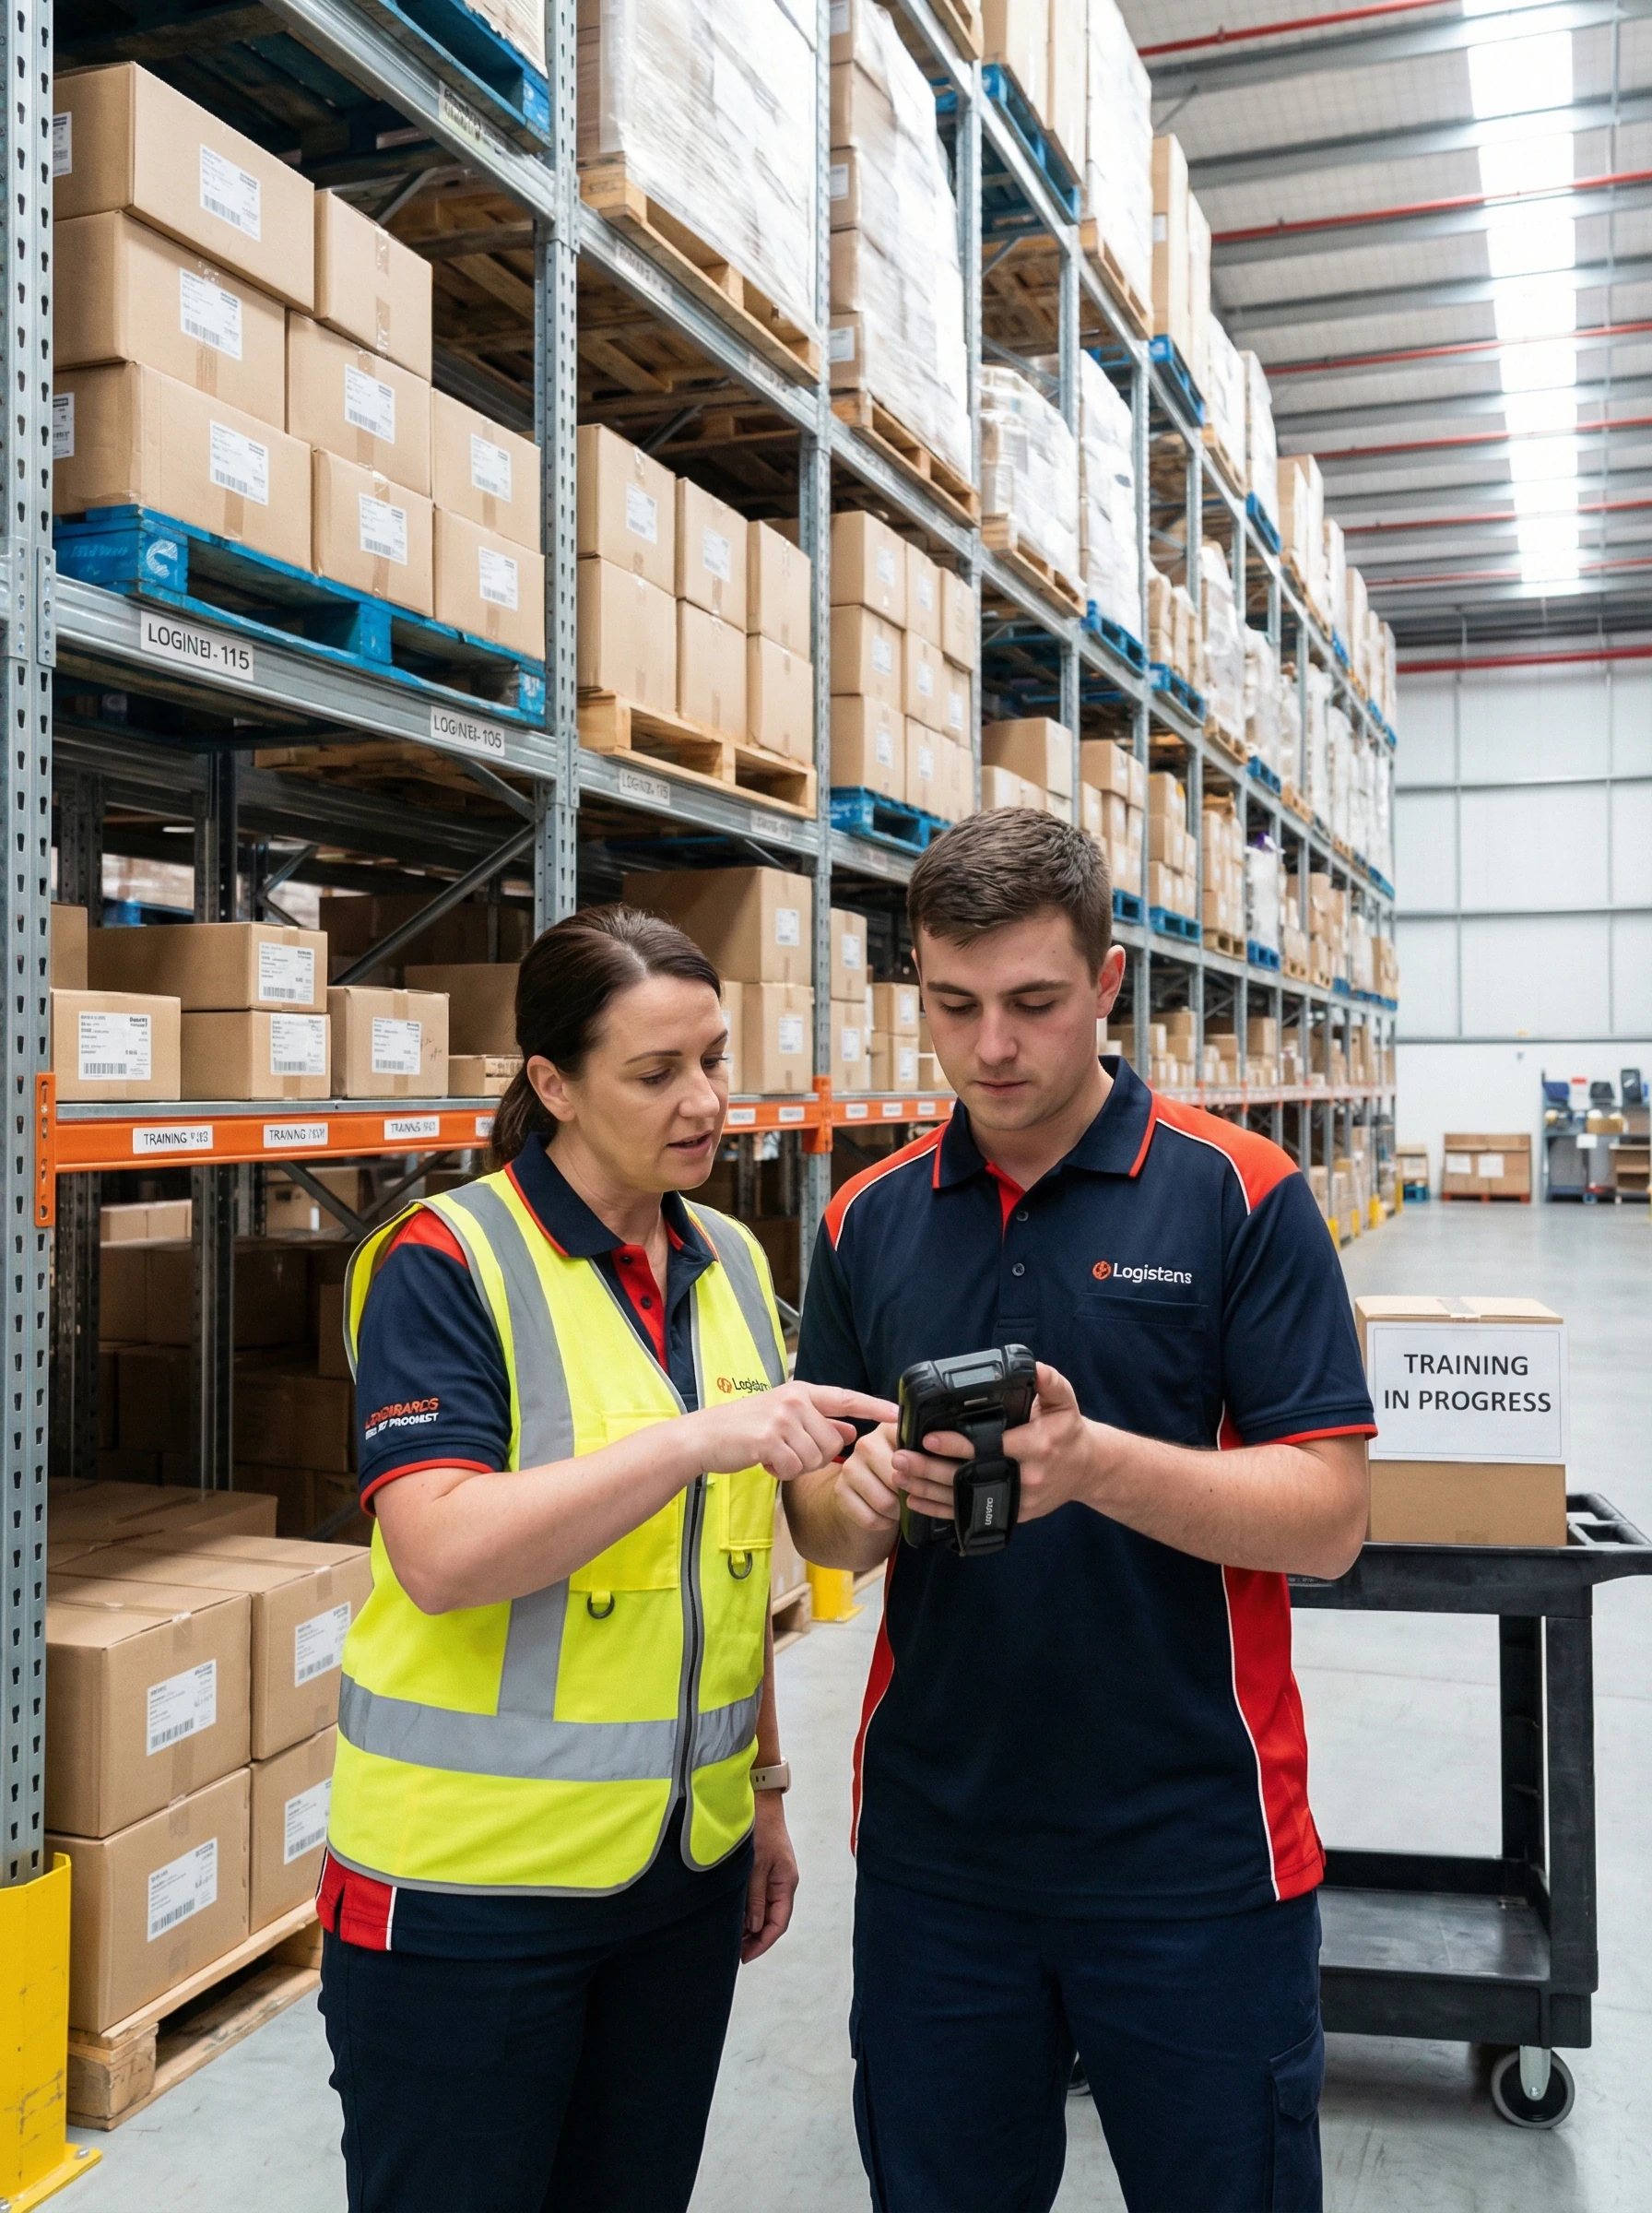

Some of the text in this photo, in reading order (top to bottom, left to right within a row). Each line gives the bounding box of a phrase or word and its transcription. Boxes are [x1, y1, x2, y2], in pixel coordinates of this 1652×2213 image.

[144, 1132, 187, 1145] TRAINING
[1404, 1354, 1528, 1376] TRAINING
[1385, 1390, 1552, 1413] IN PROGRESS
